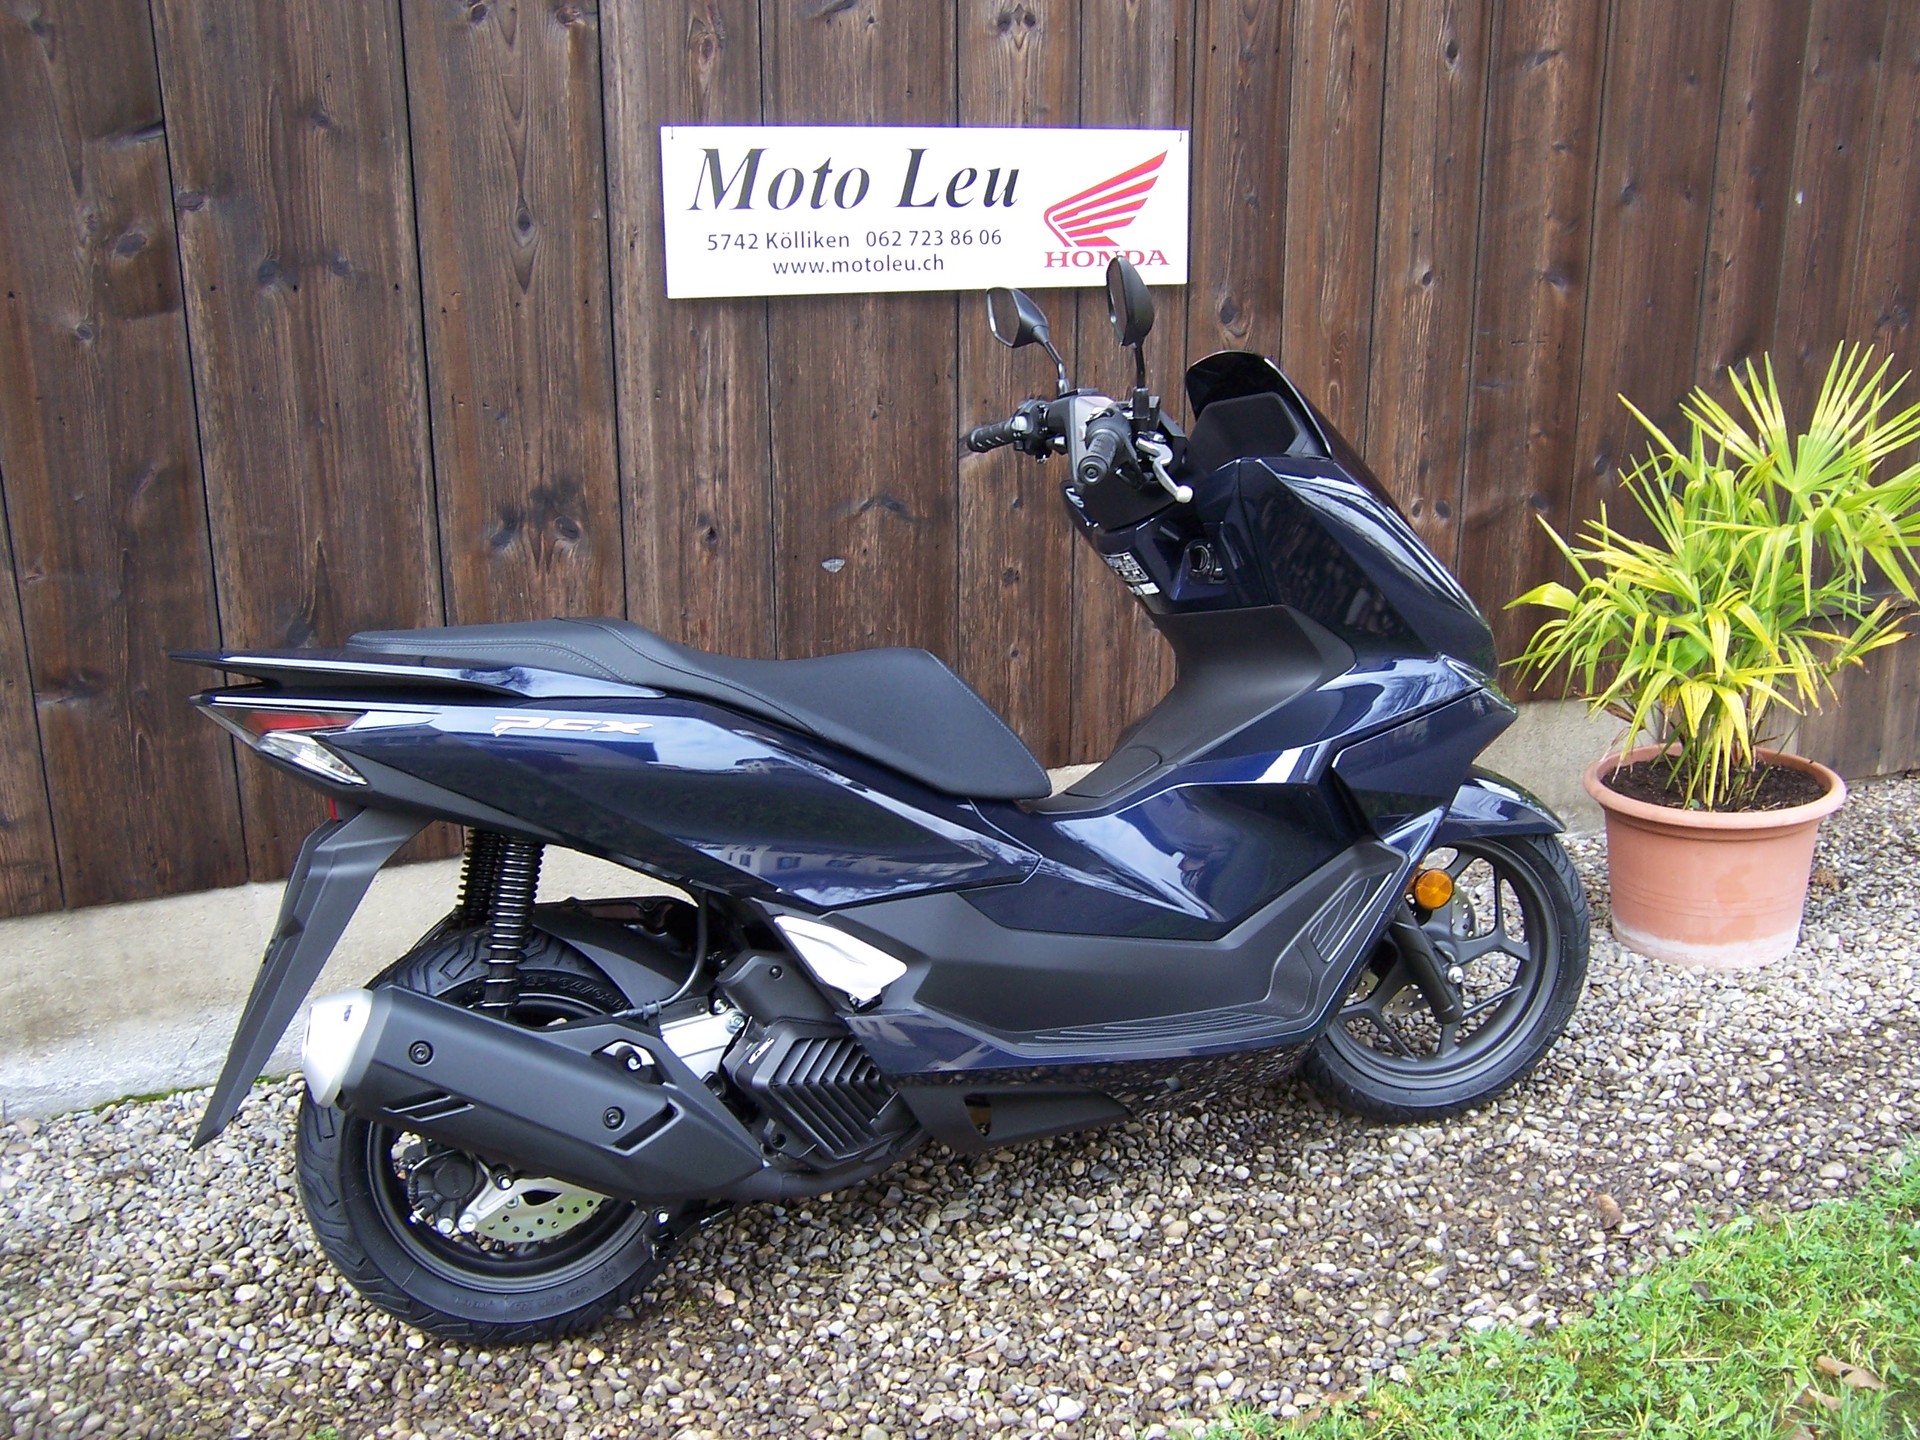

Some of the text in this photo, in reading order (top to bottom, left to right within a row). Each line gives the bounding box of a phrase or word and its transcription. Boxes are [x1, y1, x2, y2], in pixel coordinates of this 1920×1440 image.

[687, 148, 1020, 211] Moto Leu
[707, 229, 1002, 251] 5742 Kölliken 062 723 86 06
[772, 253, 944, 275] www.motoleu.ch
[490, 715, 654, 738] PCX
